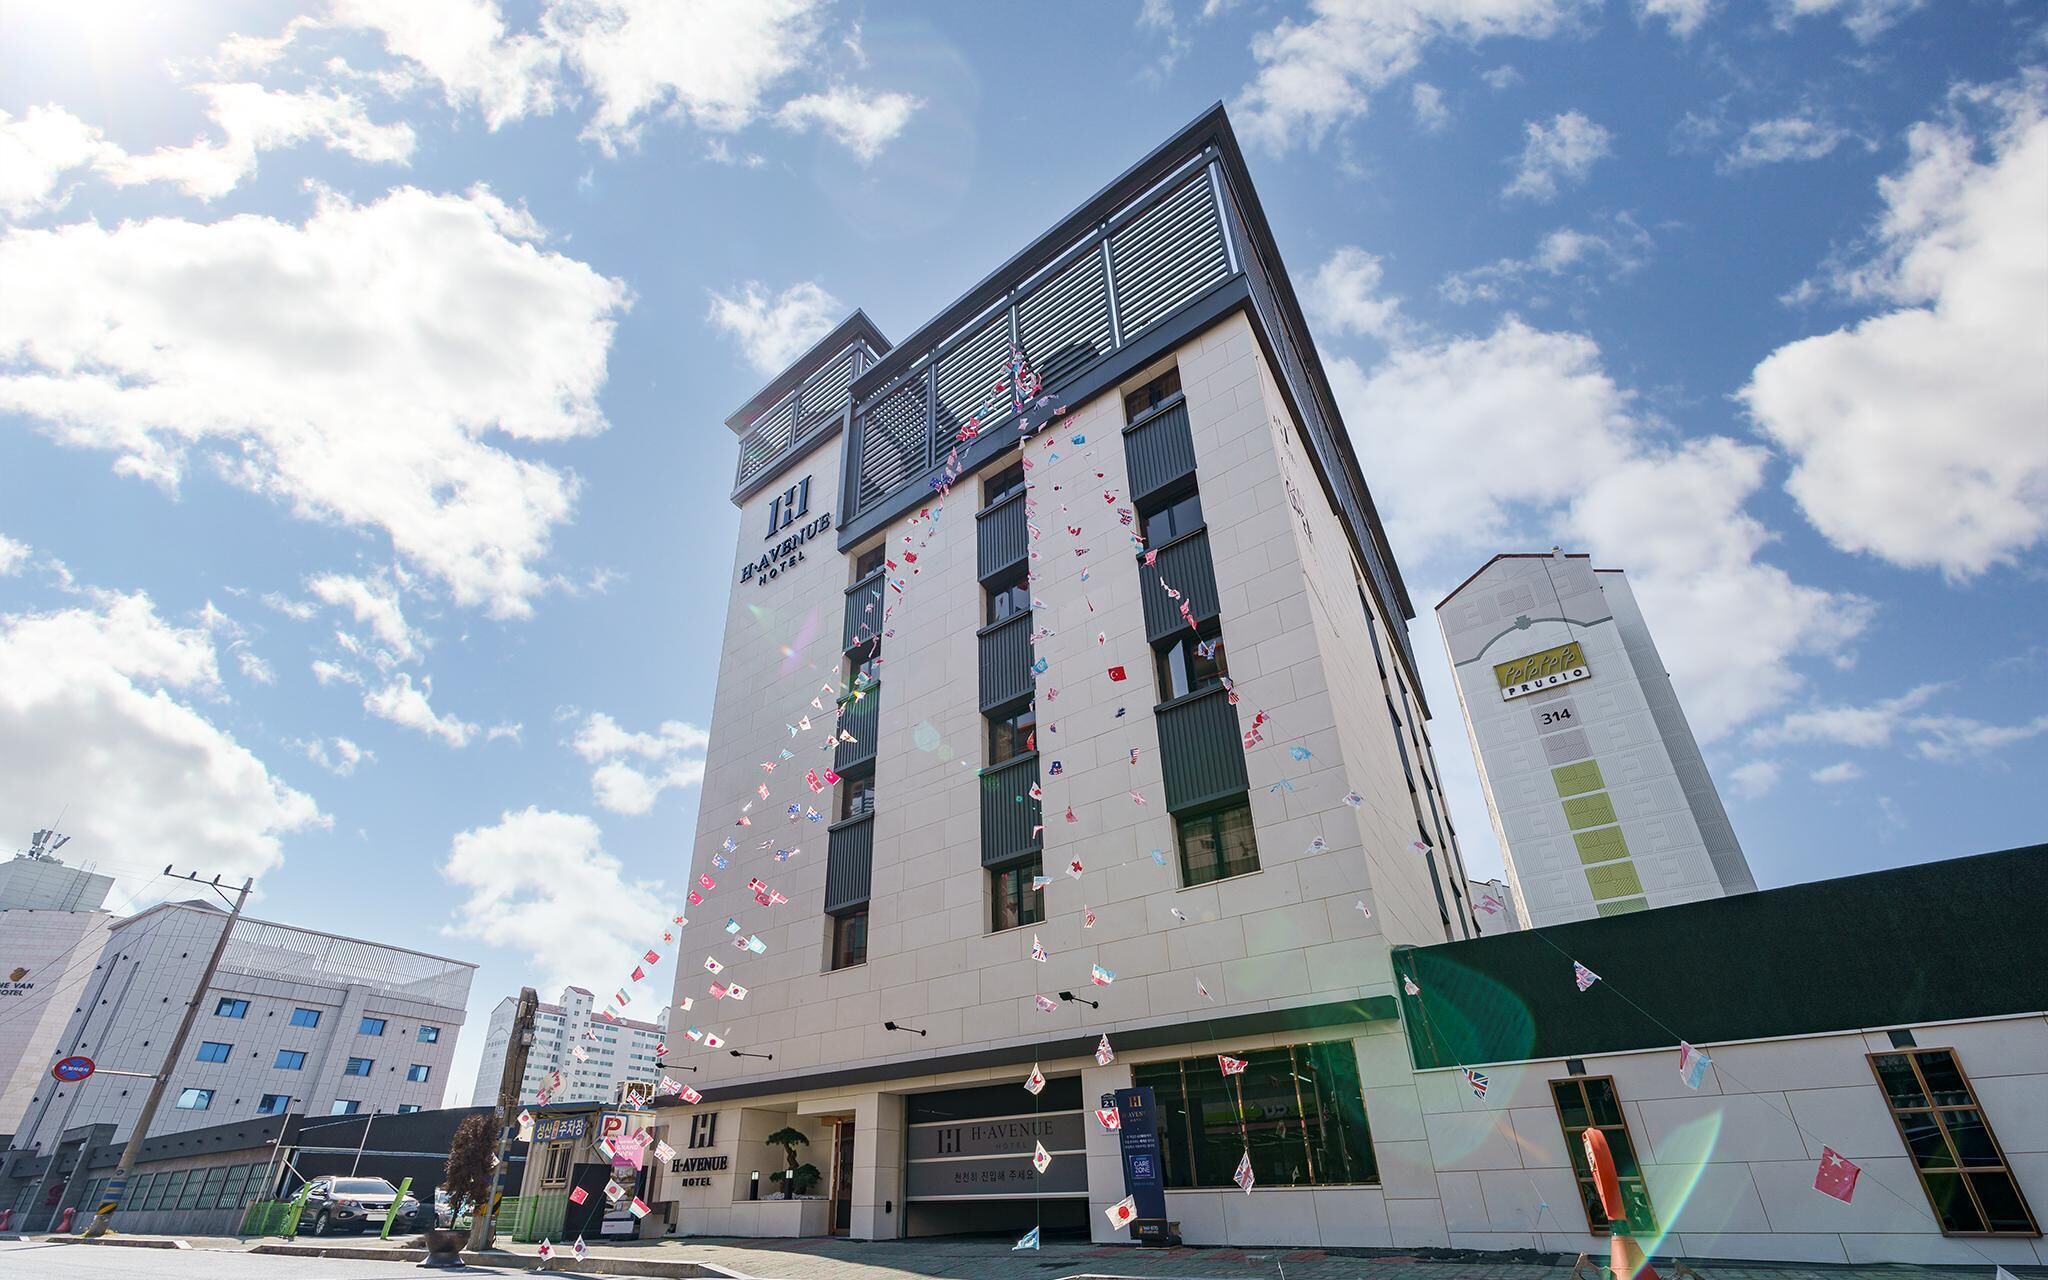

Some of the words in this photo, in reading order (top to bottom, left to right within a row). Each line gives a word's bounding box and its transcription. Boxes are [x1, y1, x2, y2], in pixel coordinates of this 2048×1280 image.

[758, 551, 805, 586] HOTEL
[1508, 669, 1582, 696] PRUGIO
[1541, 708, 1571, 725] 314
[558, 1119, 584, 1137] 주차장
[996, 1142, 1027, 1150] HOTEL
[682, 1177, 711, 1187] HOTEL
[1009, 1169, 1034, 1180] 주세요
